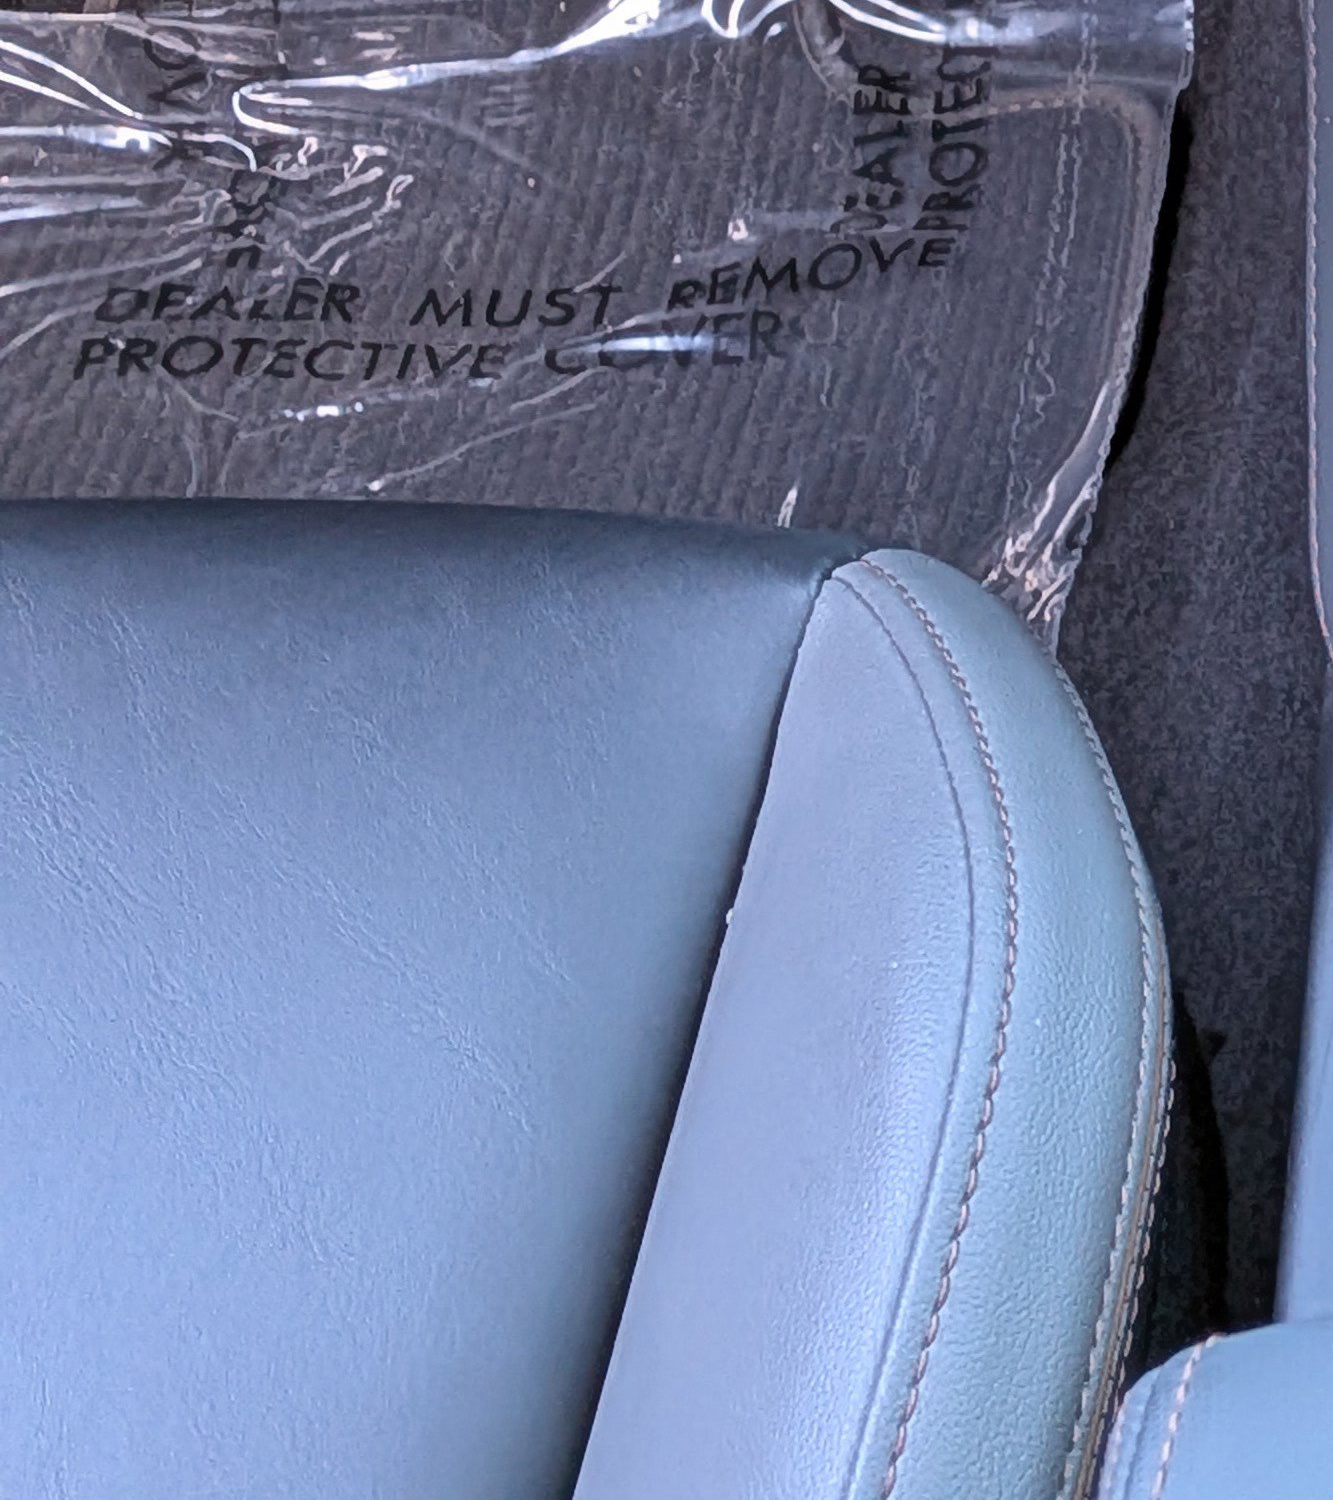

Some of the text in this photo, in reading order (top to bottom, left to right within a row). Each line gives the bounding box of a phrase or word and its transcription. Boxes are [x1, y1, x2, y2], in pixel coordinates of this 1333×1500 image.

[94, 236, 956, 328] DEALER MUST REMOVE
[73, 335, 511, 380] PROTECTIVE
